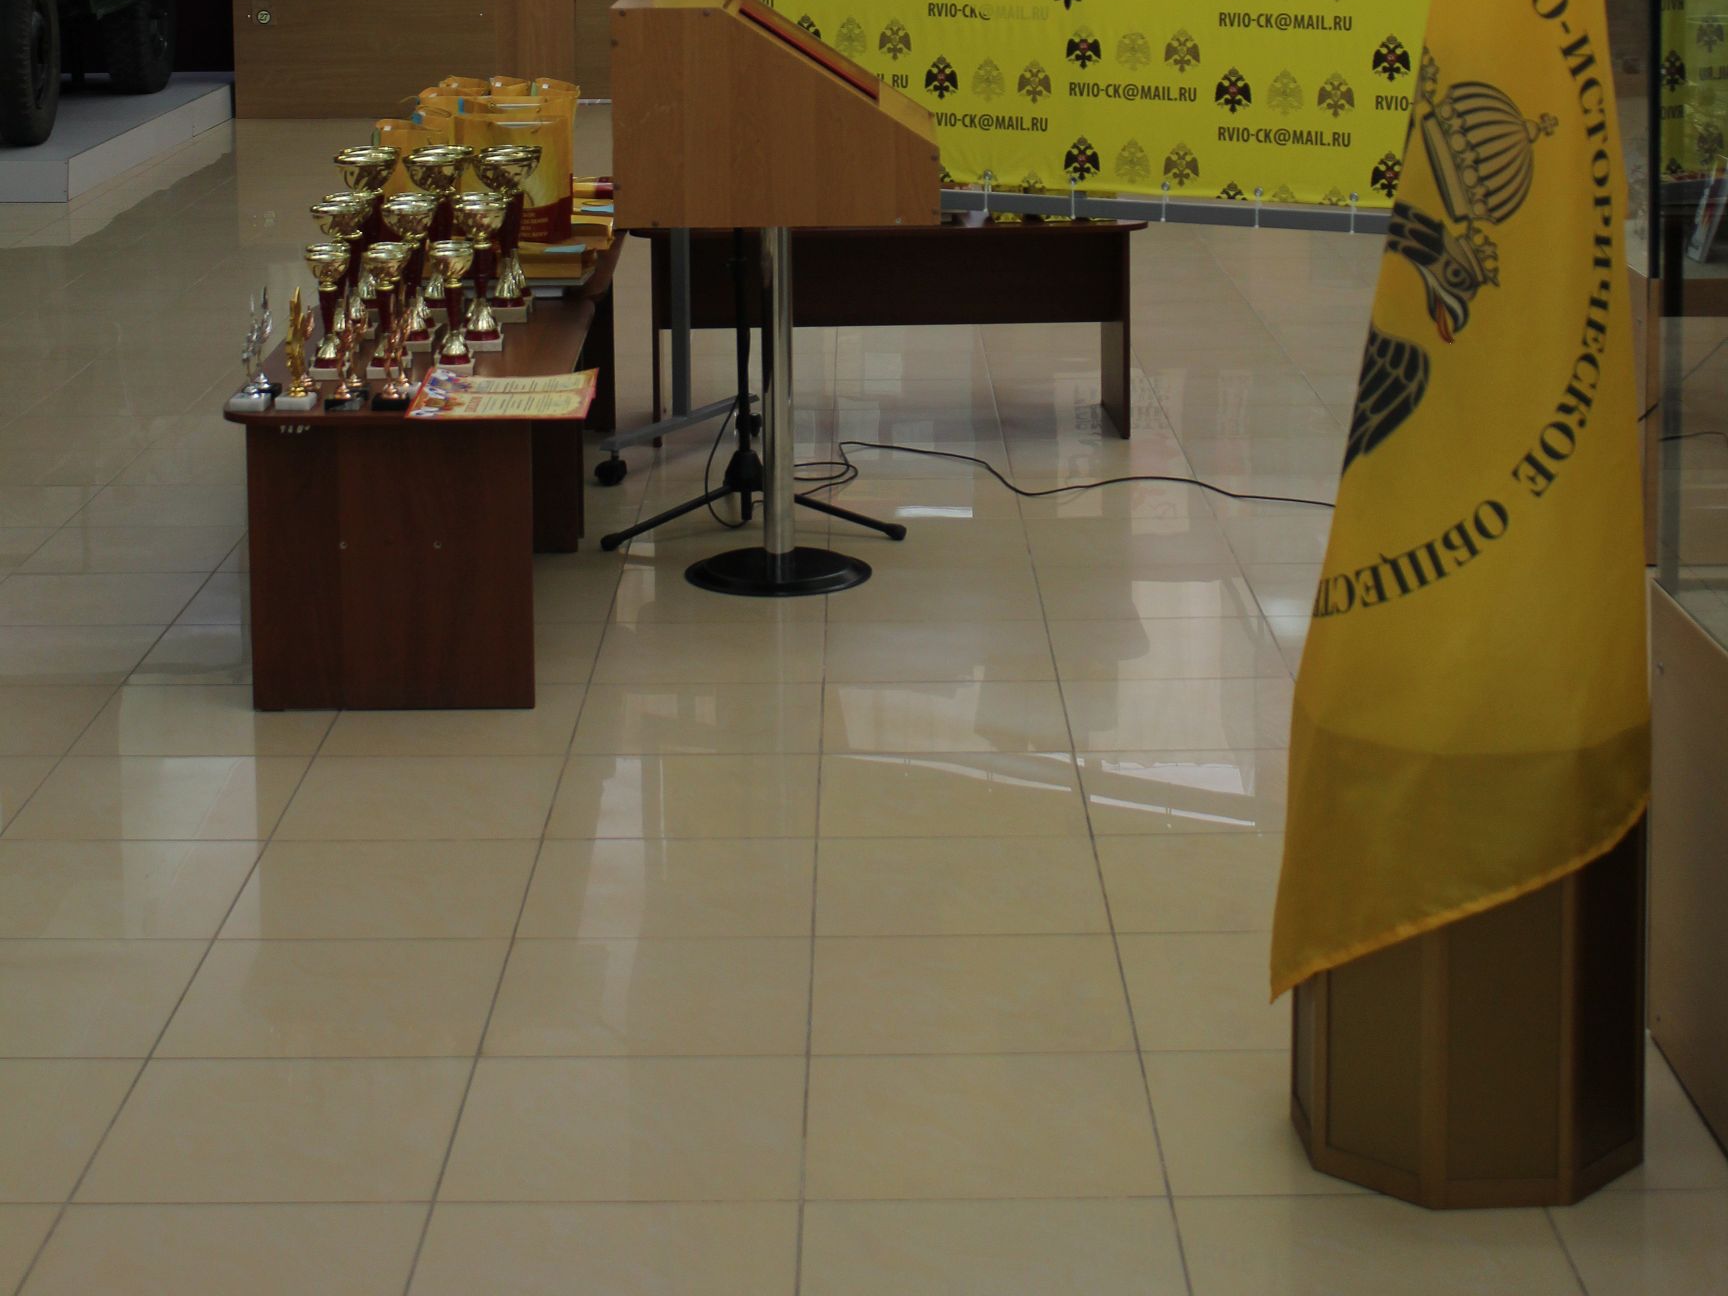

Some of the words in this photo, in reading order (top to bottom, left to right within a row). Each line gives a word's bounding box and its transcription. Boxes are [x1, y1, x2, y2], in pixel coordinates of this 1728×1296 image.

[1218, 11, 1353, 32] RVIO-CK@MAIL.RU
[1067, 81, 1198, 103] RVIO-CK@MAIL.RU
[934, 110, 1049, 134] VIO-CK@MAIL.RU
[1217, 126, 1352, 148] RVIO-CK@MAIL.RU
